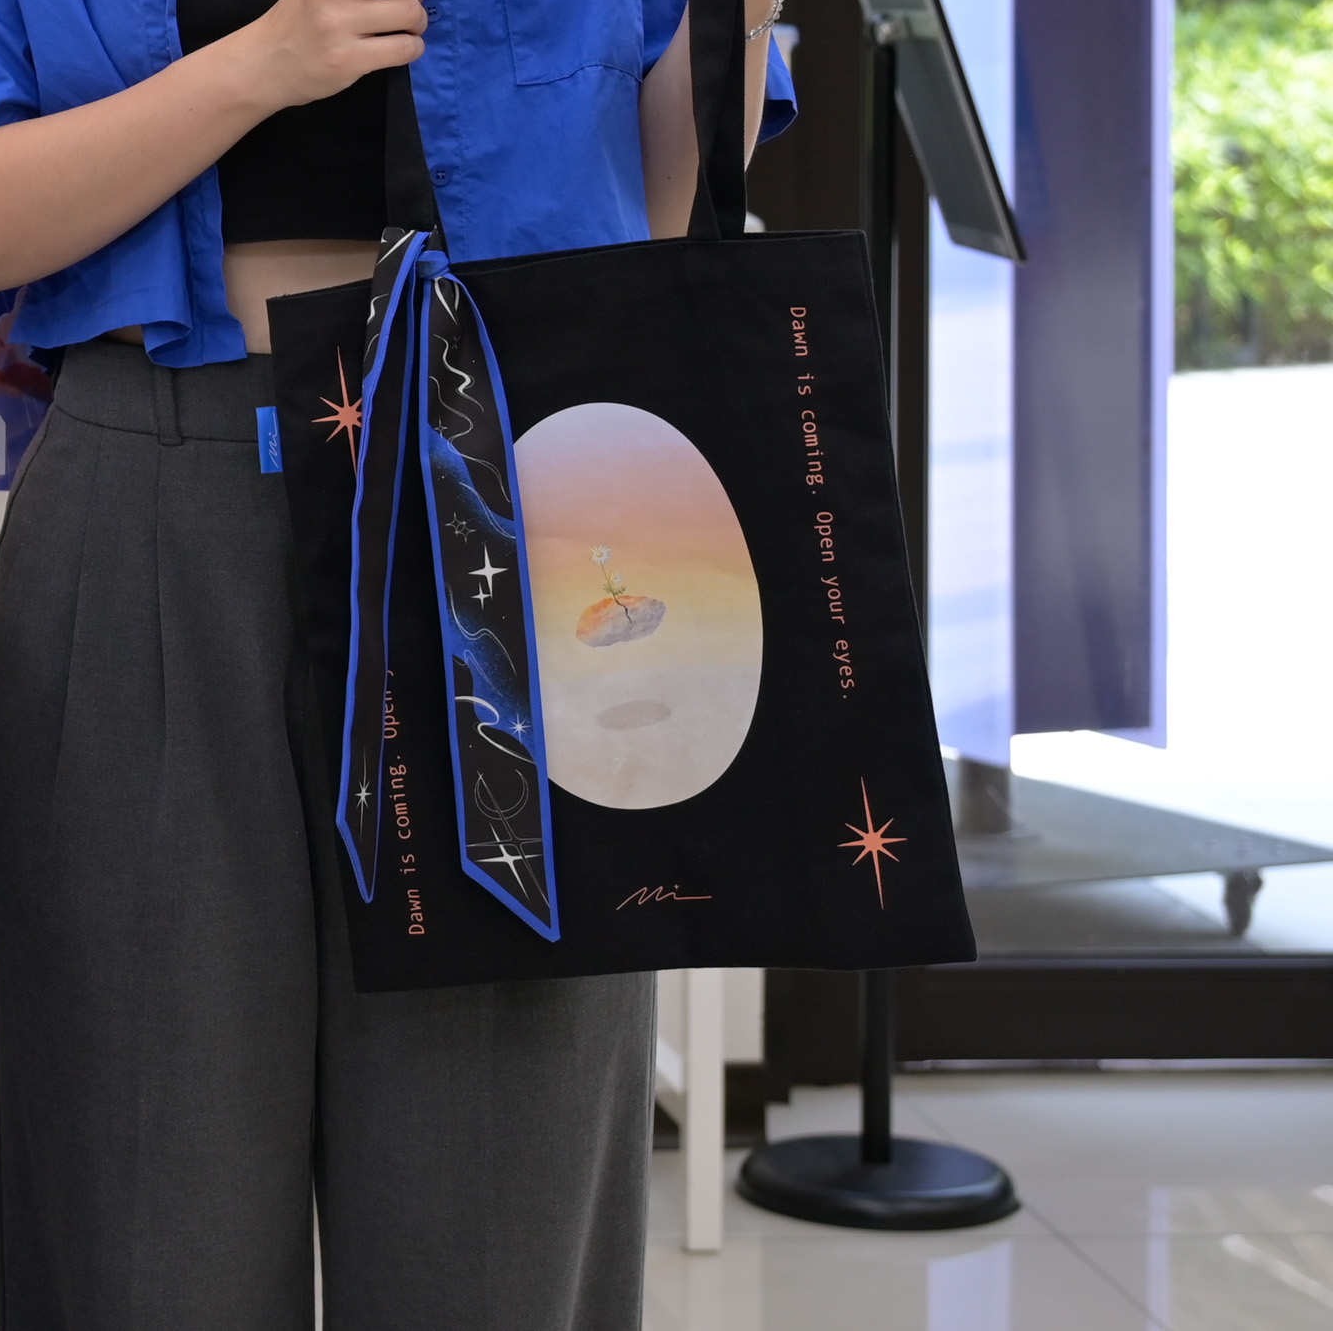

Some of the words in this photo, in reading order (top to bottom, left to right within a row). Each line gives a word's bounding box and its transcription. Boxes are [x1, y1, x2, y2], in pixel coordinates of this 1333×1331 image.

[789, 306, 808, 357] Dawn
[797, 373, 815, 395] is
[801, 410, 824, 495] coming.
[813, 511, 835, 562] Open
[820, 576, 846, 624] your
[833, 639, 855, 699] eyes.
[390, 755, 412, 840] coming.
[399, 853, 416, 875] is
[408, 889, 425, 935] Dawn
